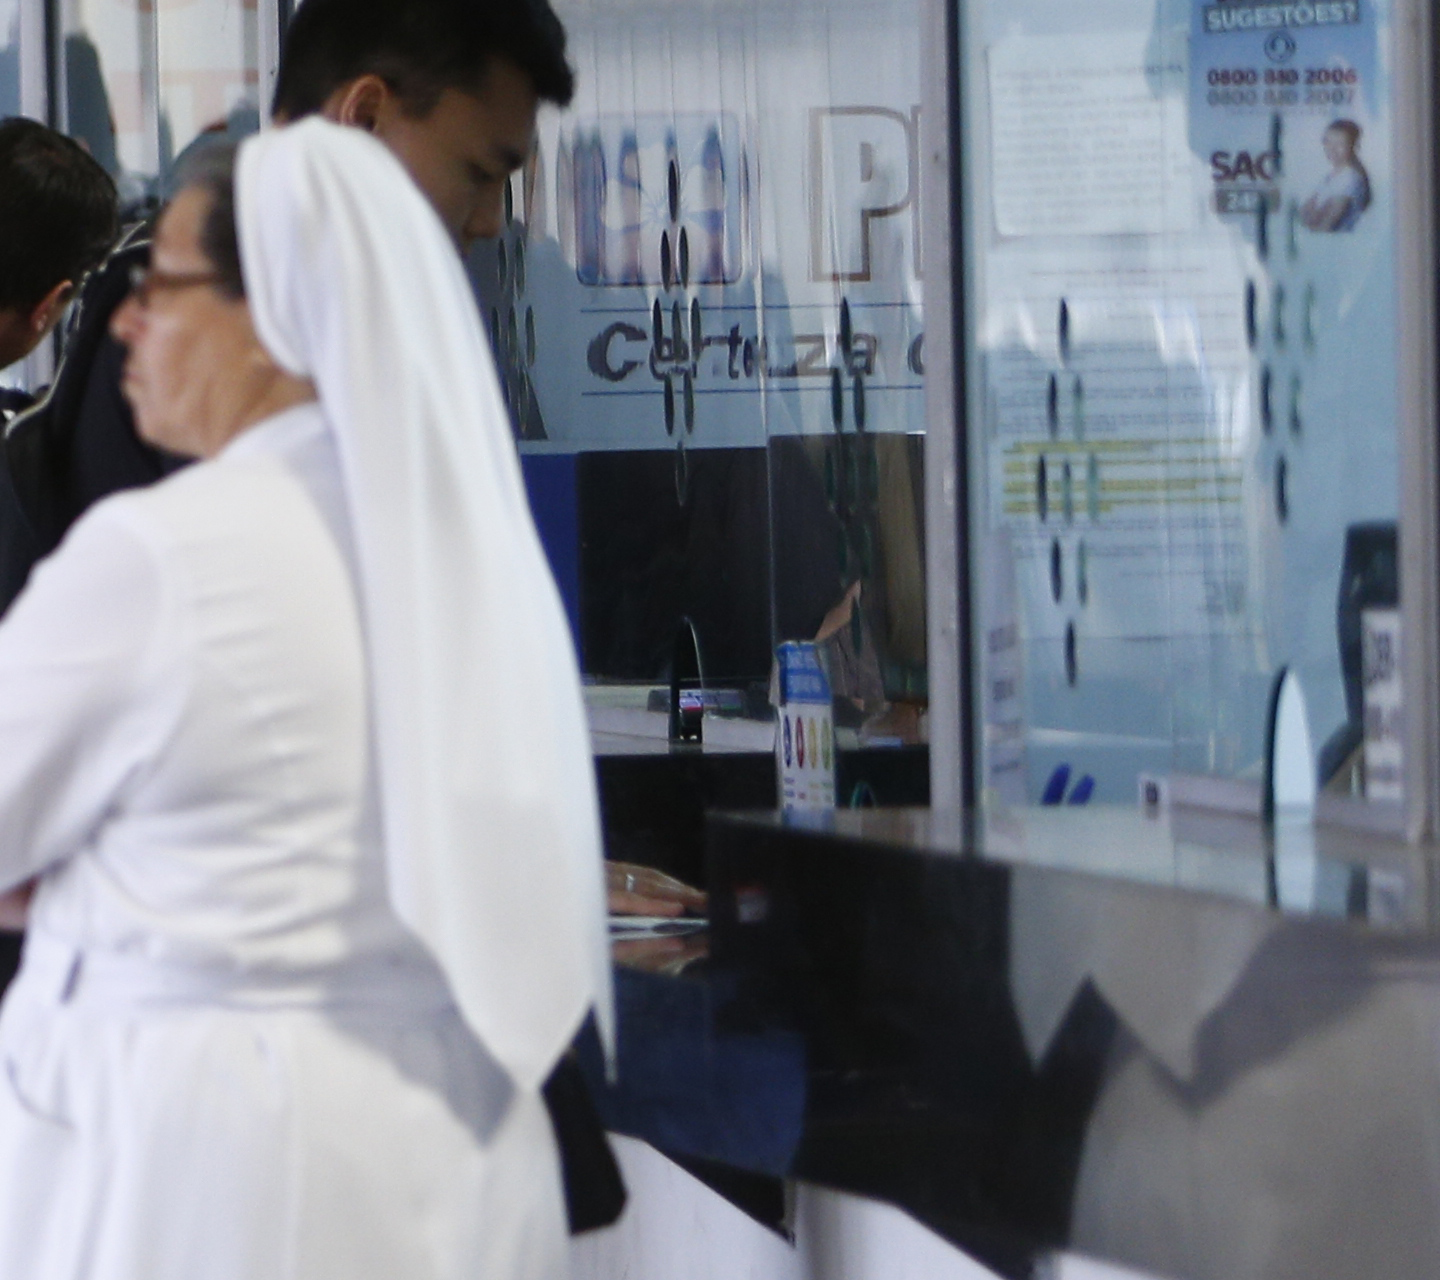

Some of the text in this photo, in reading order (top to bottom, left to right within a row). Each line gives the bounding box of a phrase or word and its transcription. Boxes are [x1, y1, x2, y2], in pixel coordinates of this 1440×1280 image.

[1205, 2, 1359, 32] SUGESTÕES?
[1207, 67, 1258, 86] 0800
[1305, 67, 1357, 86] 2006
[1210, 149, 1280, 182] SAC
